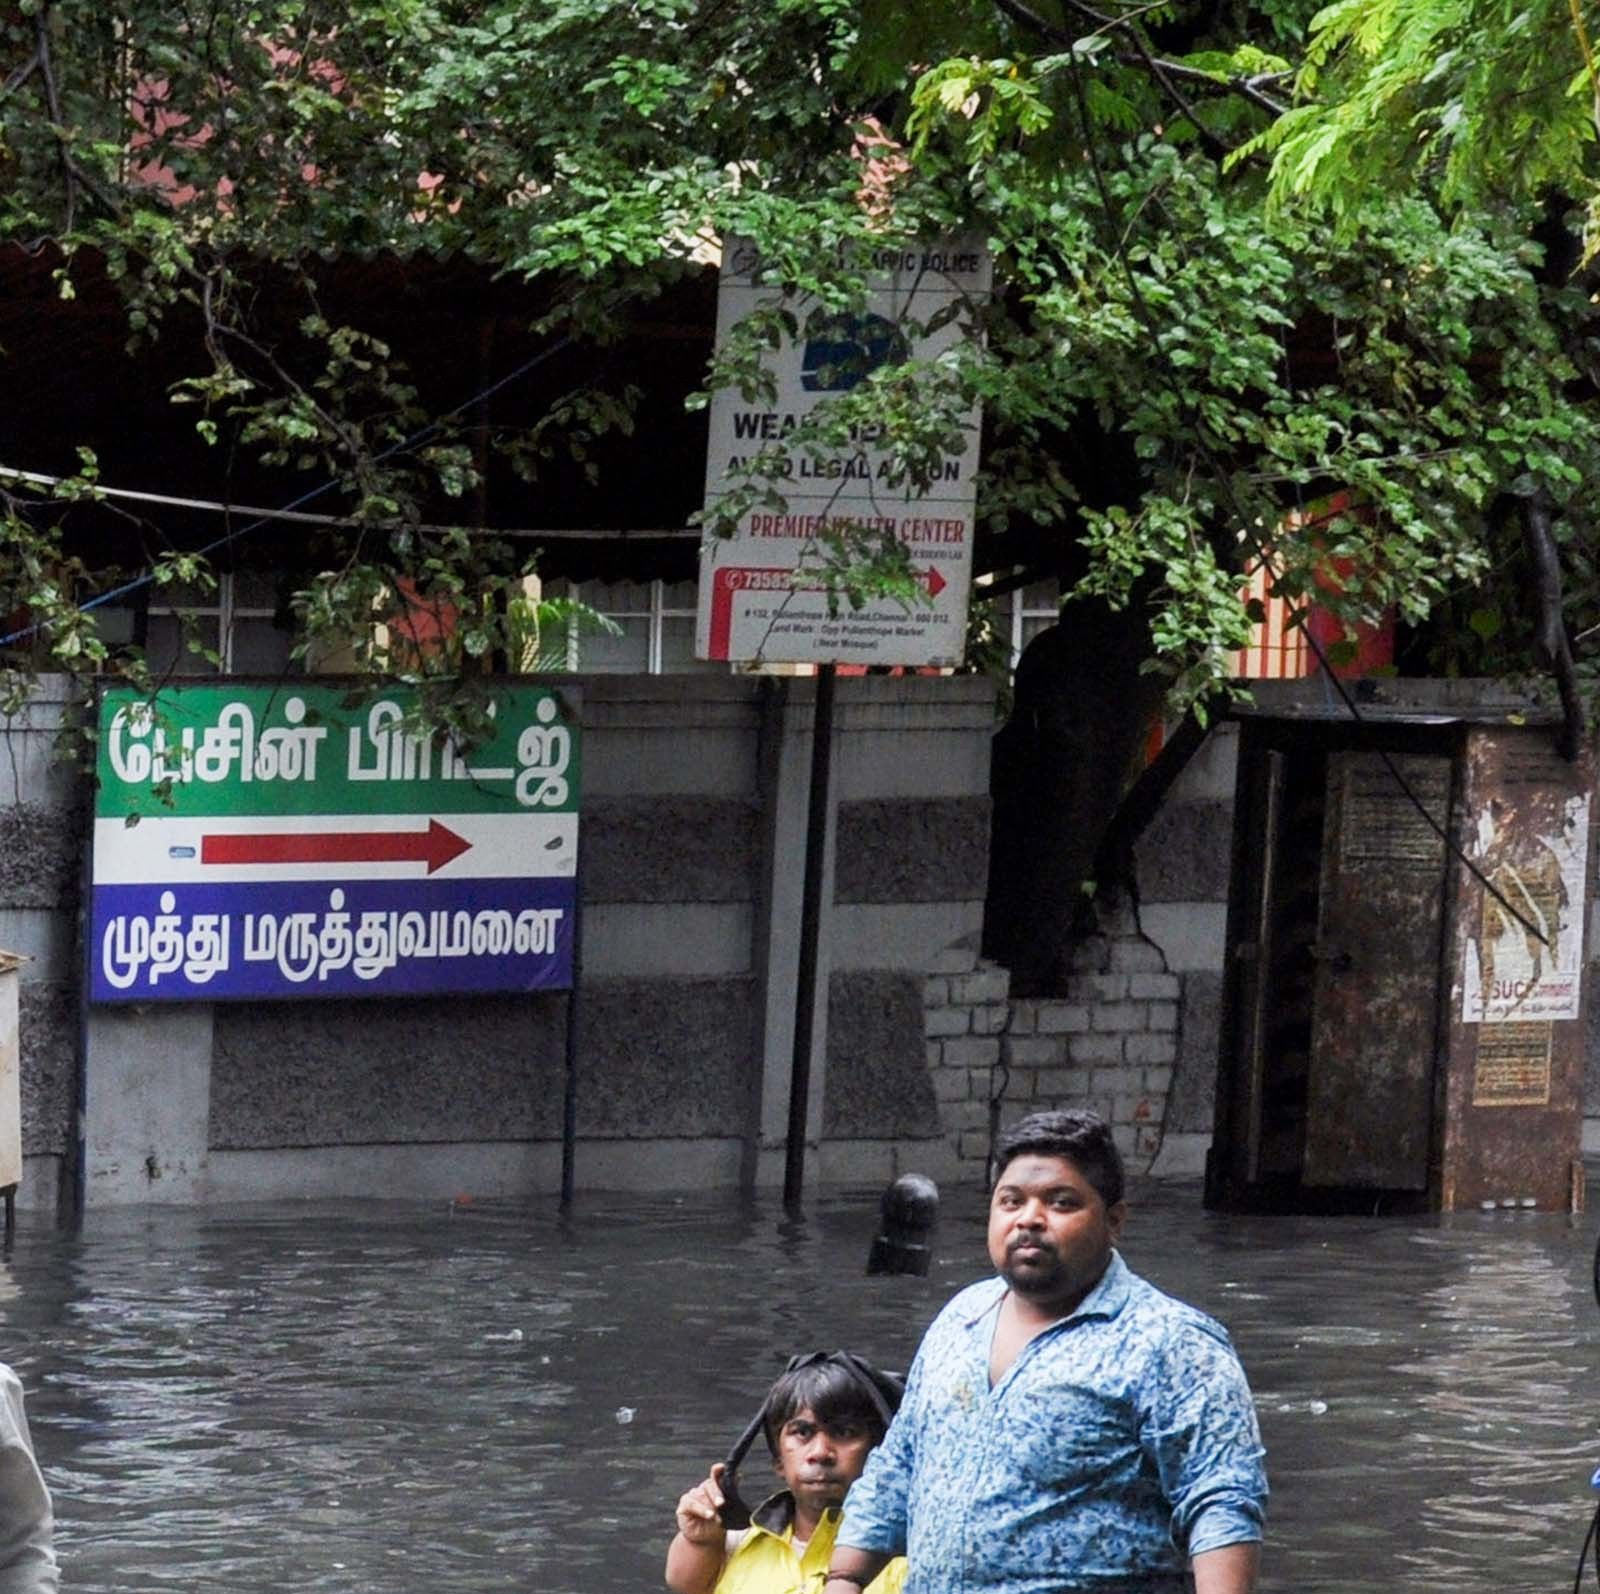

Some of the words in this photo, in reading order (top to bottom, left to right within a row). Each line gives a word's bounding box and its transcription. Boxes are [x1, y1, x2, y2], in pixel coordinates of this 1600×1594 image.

[800, 457, 871, 480] LEGAL
[900, 519, 965, 543] CENTER
[108, 696, 328, 784] பேசின்
[102, 889, 231, 989] முத்து
[243, 887, 564, 982] மருத்துவமனை
